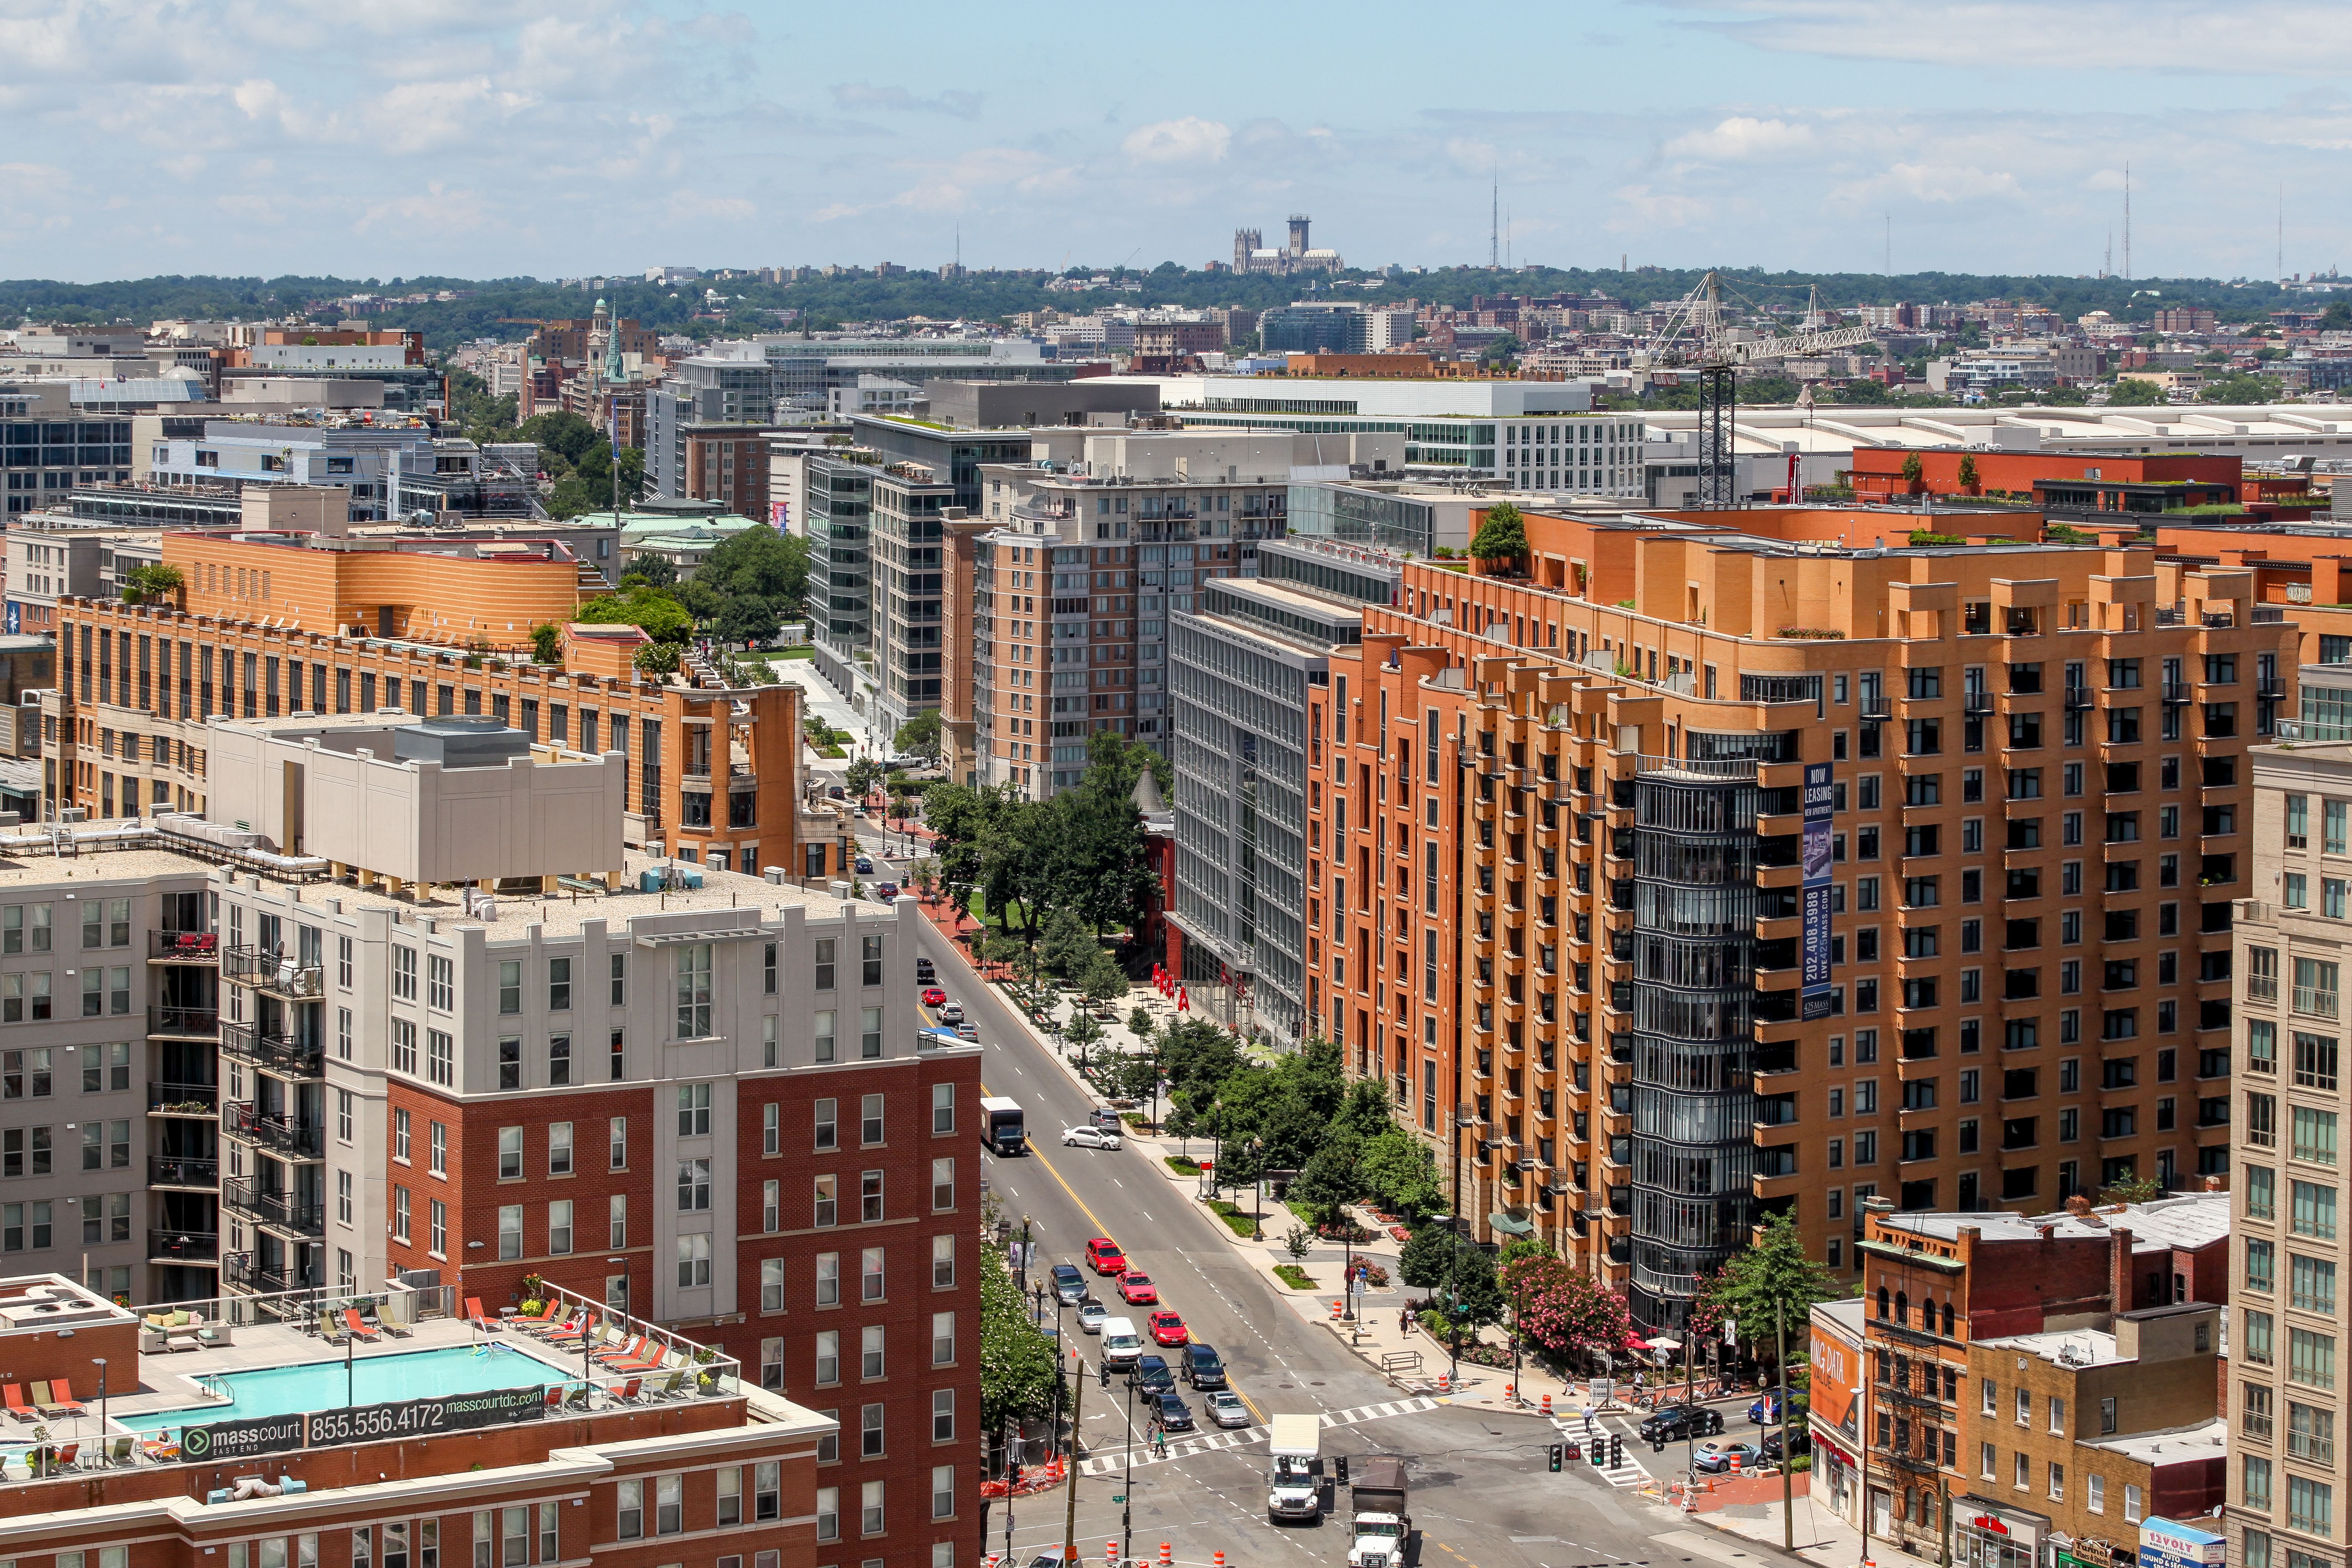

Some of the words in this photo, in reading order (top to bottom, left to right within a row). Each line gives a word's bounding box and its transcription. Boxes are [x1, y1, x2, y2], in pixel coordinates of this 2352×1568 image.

[1811, 768, 1825, 784] NOW
[1805, 786, 1831, 803] LEASING
[1812, 805, 1831, 815] APARTMENTS
[1806, 891, 1818, 981] 202.408.5988
[1820, 890, 1828, 979] LIVE425MASS.COM
[1827, 1346, 1845, 1384] DATA.
[446, 1390, 542, 1414] masscourtdc.com
[312, 1404, 444, 1441] 855.556.4172
[213, 1421, 300, 1447] masscourt
[214, 1447, 236, 1456] EAST
[240, 1444, 258, 1453] END
[2076, 1541, 2108, 1558] Tunnel
[2076, 1549, 2089, 1560] Wines
[2094, 1555, 2109, 1566] Spirits
[2161, 1552, 2181, 1563] AUTO
[2165, 1546, 2193, 1558] ELECTRONICS
[2141, 1553, 2164, 1564] SOUND
